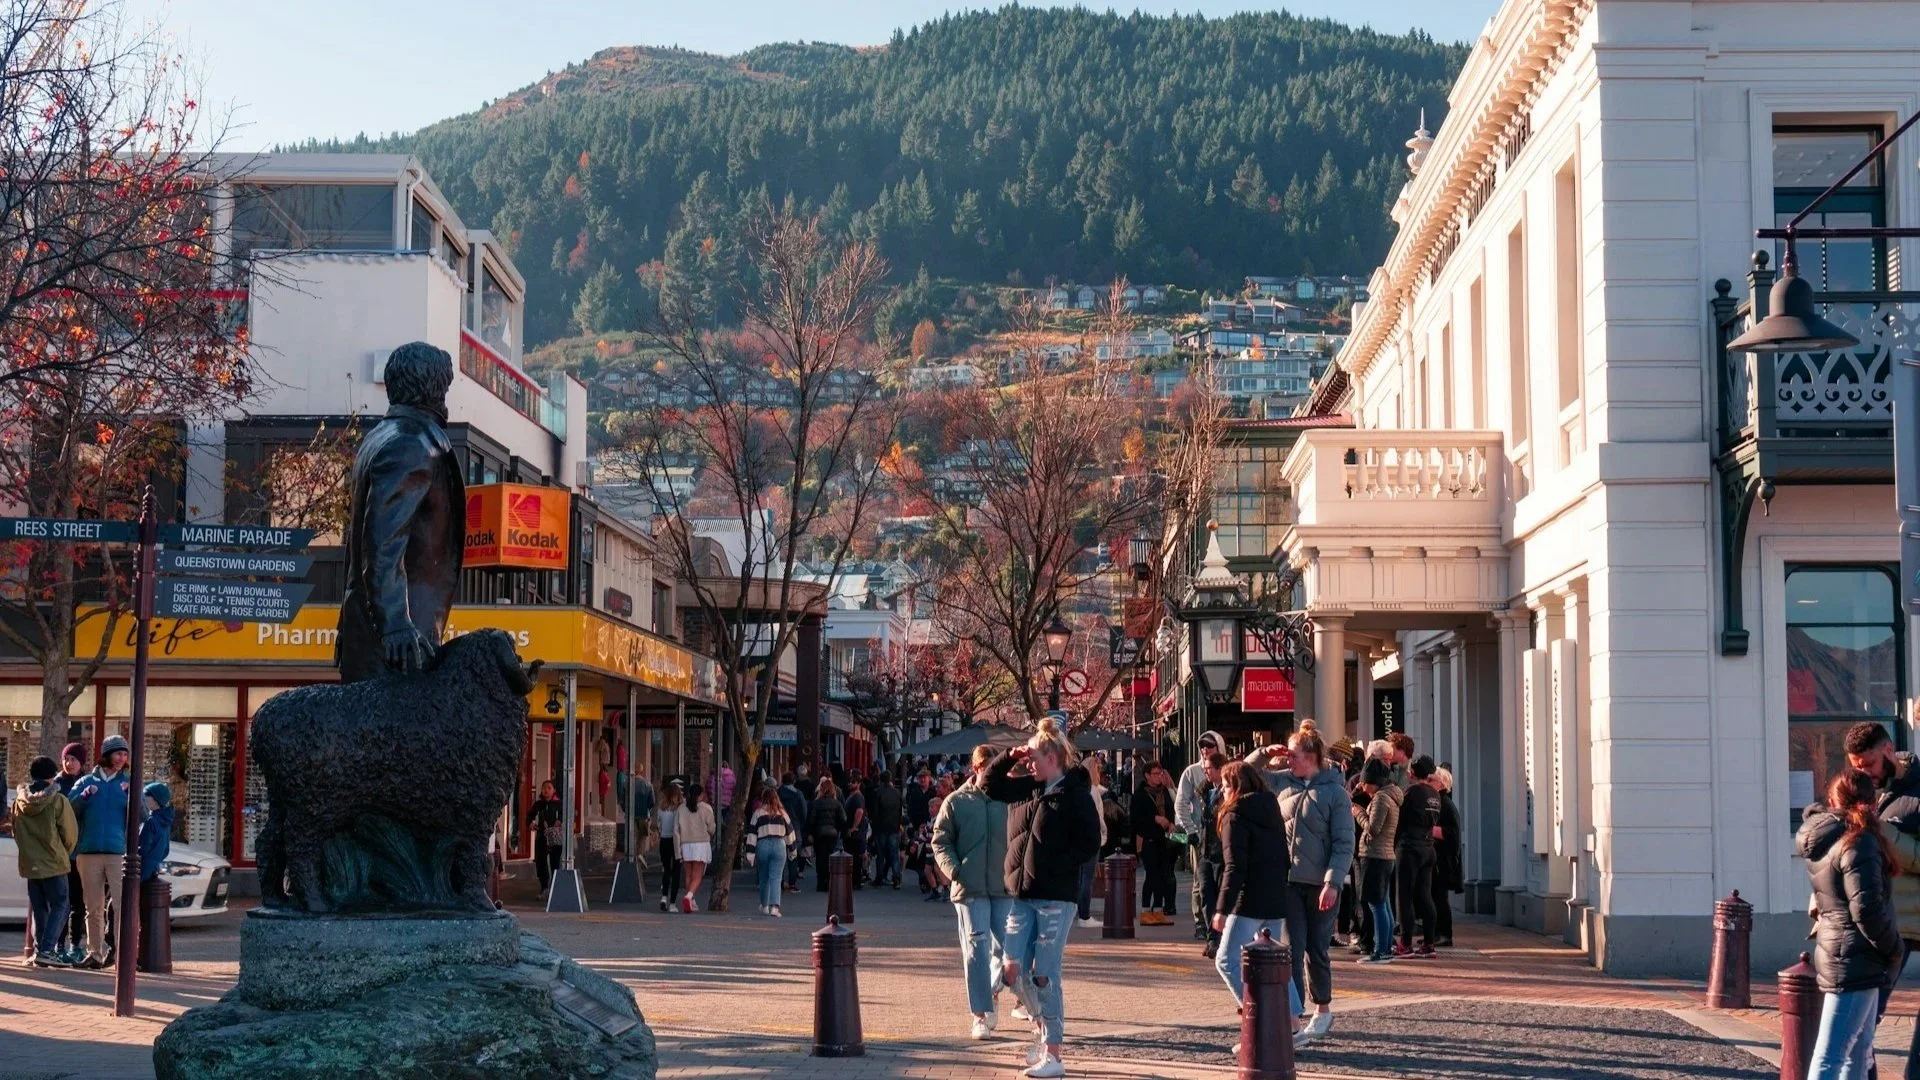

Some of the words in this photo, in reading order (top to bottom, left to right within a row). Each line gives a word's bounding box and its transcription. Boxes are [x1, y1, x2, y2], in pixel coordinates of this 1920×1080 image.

[15, 521, 47, 536] REES
[53, 522, 103, 538] STREET
[181, 527, 235, 544] MARINE
[239, 529, 292, 545] PARADE
[464, 529, 496, 548] odak
[507, 528, 560, 548] Kodak
[538, 549, 563, 560] FILM
[175, 556, 245, 570] QUEENSTOWN
[248, 558, 296, 572] GARDENS
[173, 583, 190, 593] ICE
[192, 584, 209, 594] RINK
[218, 585, 242, 596] LAWN
[243, 586, 282, 598] BOWLING
[173, 594, 193, 603] DISC
[195, 595, 217, 605] GOLF
[225, 596, 255, 606] TENNIS
[257, 597, 290, 608] COURTS
[172, 604, 198, 614] SKATE
[200, 605, 222, 615] PARK
[231, 606, 253, 616] ROSE
[255, 607, 289, 619] GARDEN
[683, 716, 712, 726] ulture
